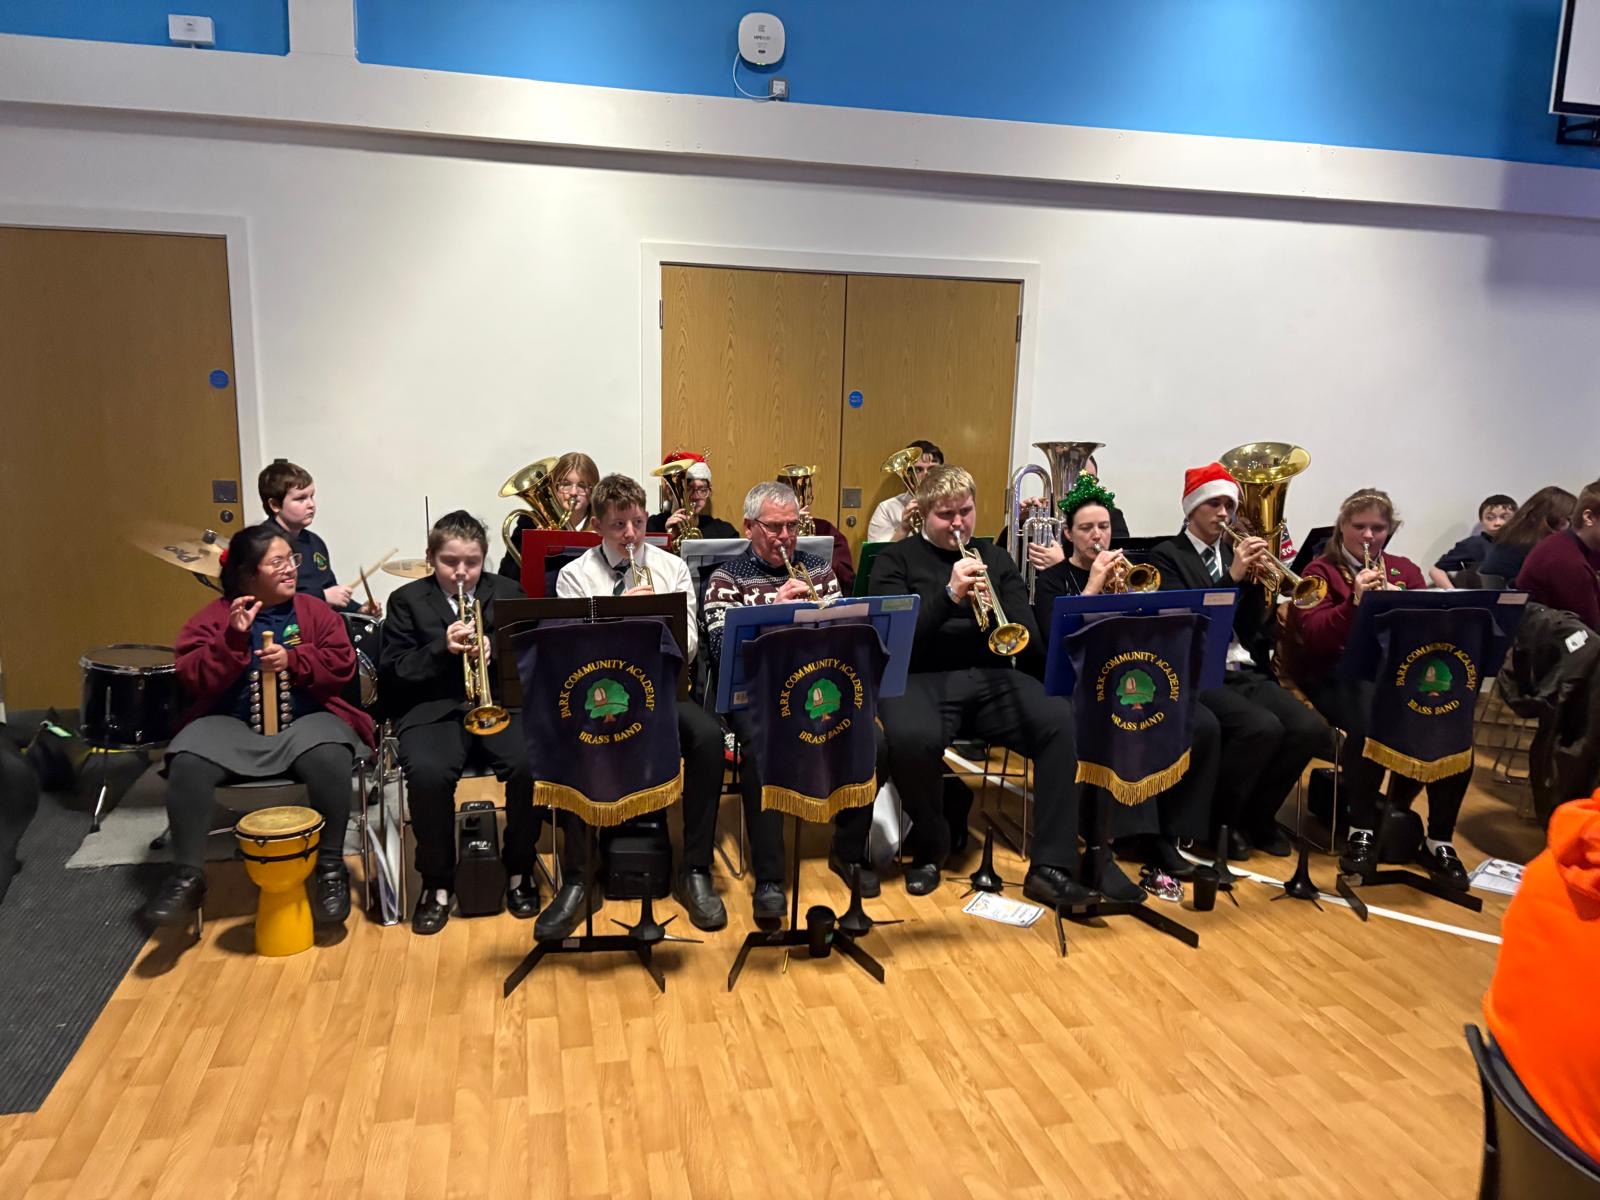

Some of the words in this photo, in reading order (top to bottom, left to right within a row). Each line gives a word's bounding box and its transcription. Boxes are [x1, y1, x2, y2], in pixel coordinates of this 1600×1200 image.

[564, 660, 627, 689] COMMUNITY
[626, 665, 655, 711] ACADEMY
[785, 659, 840, 689] COMMUNITY
[839, 663, 864, 709] ACADEMY
[1101, 651, 1157, 674] COMMUNITY
[1156, 659, 1179, 702] ACADEMY
[559, 690, 572, 718] PARK
[780, 690, 791, 717] PARK
[1434, 700, 1459, 715] BAND
[579, 731, 610, 744] BRASS
[614, 722, 642, 742] BAND
[799, 731, 827, 744] BRASS
[828, 718, 851, 739] BAND
[1140, 711, 1165, 730] BAND
